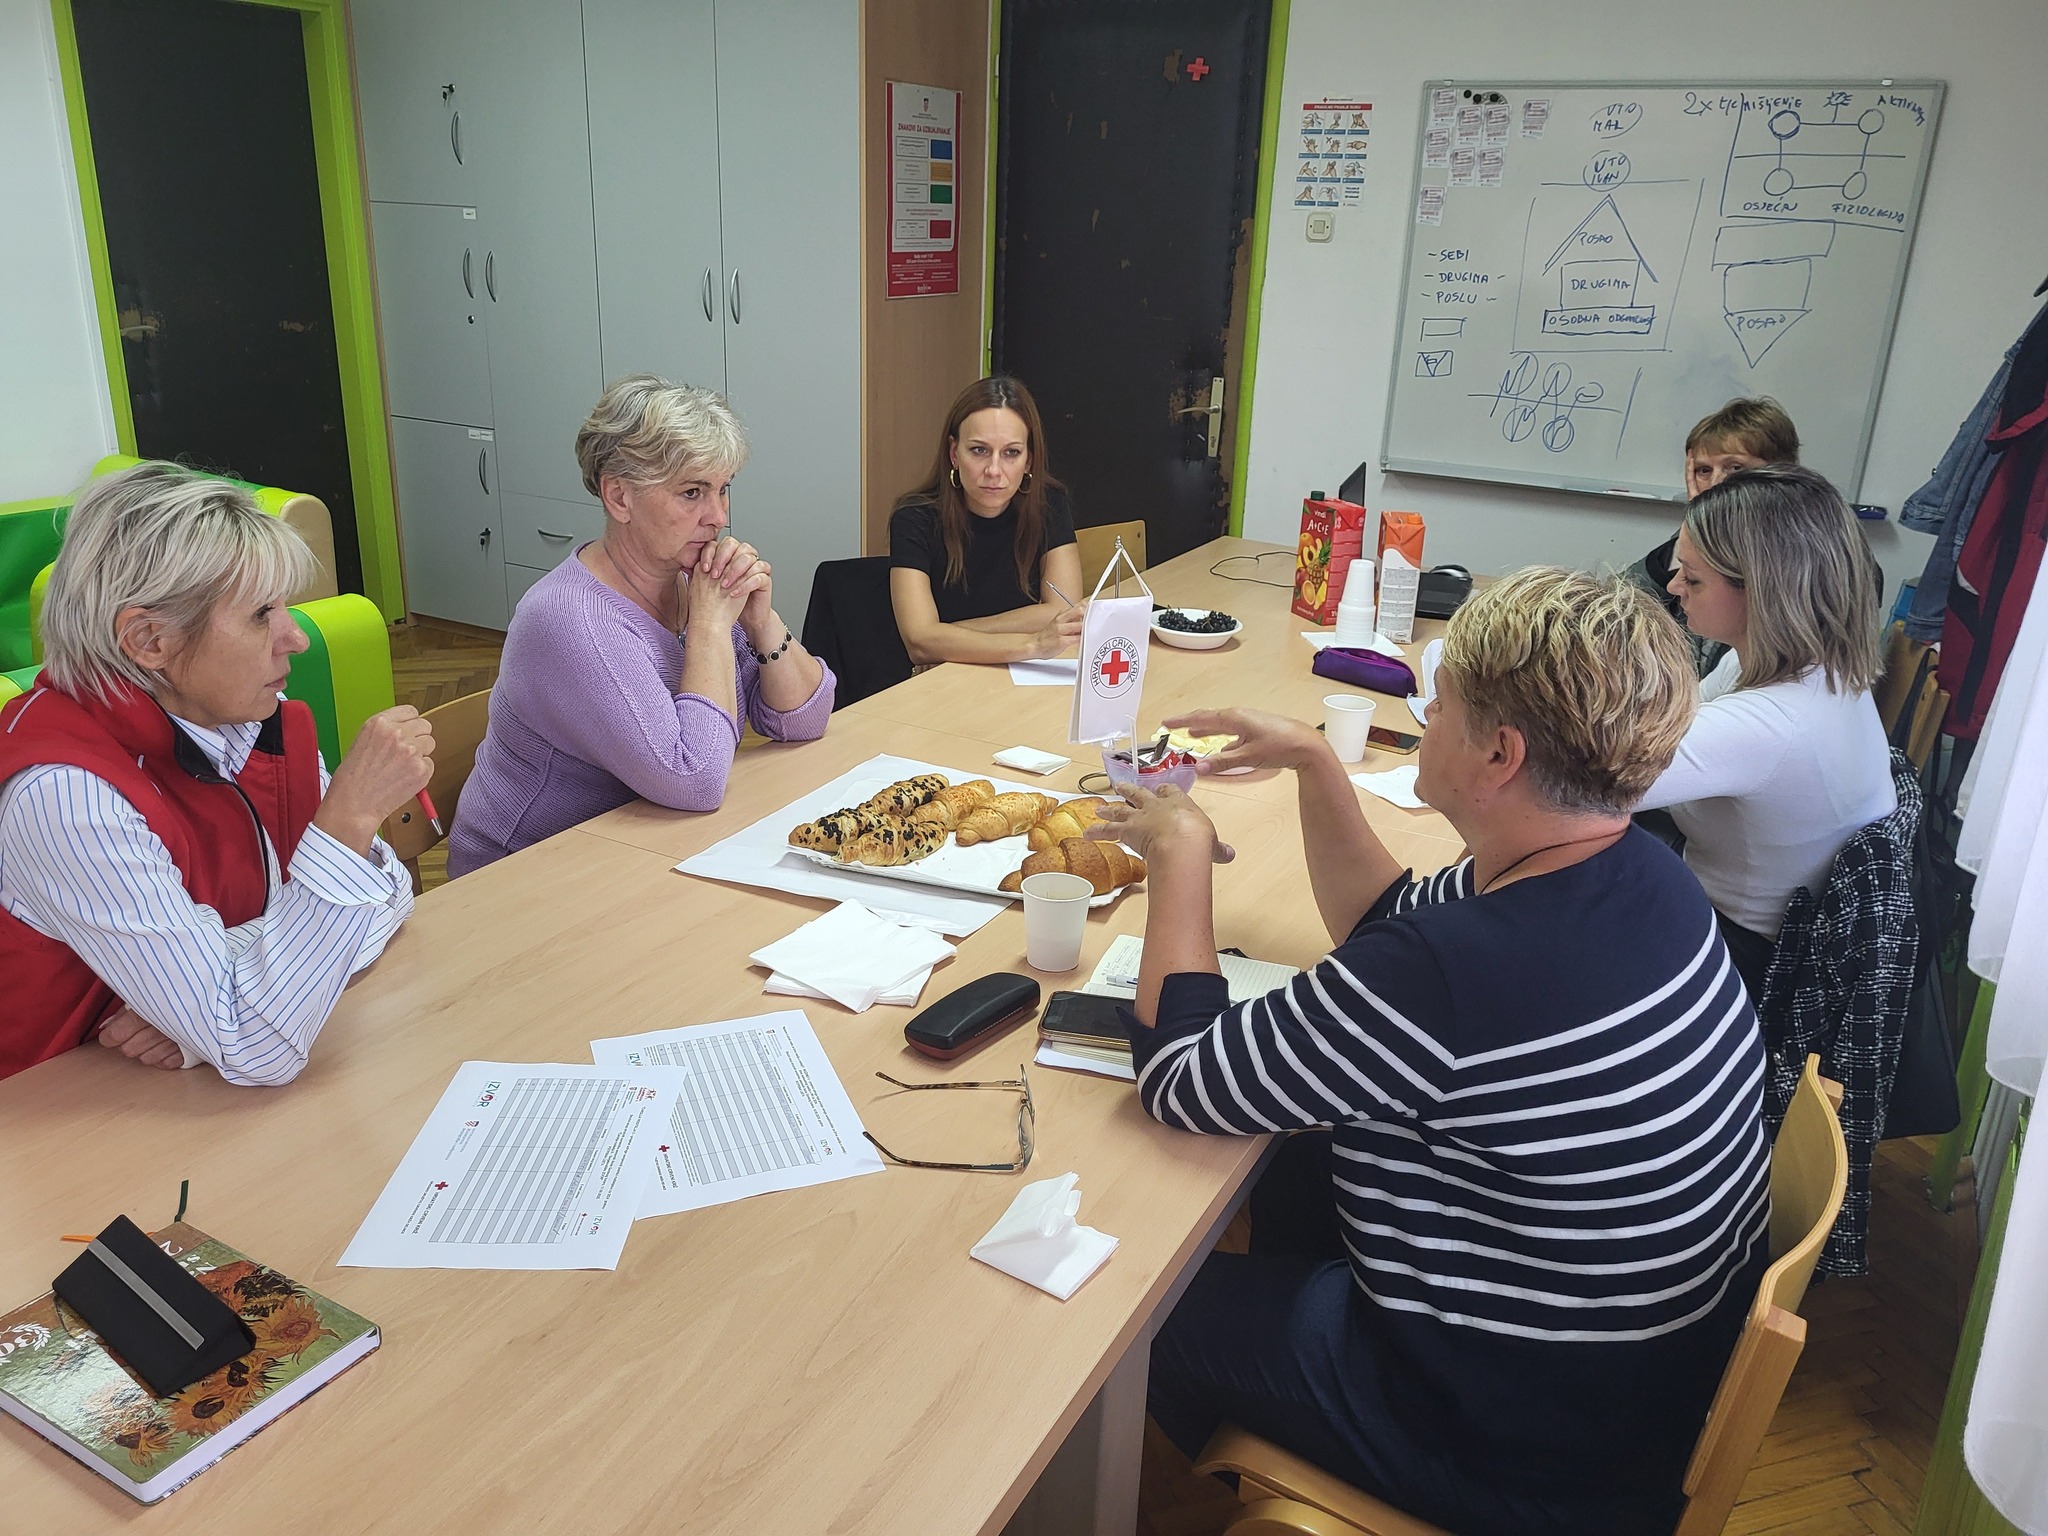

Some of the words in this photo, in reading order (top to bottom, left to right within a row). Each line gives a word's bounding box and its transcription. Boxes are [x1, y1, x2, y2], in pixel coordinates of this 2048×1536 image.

[1440, 249, 1469, 261] SEBI
[1439, 272, 1489, 284] DRUGIMA
[1571, 278, 1631, 291] DRUGIMA
[1436, 290, 1477, 304] POSLU
[1549, 314, 1600, 326] OSOBNA
[1737, 313, 1786, 332] POSAO
[1092, 641, 1111, 687] HRVATSKI
[1112, 639, 1137, 659] CRVENI
